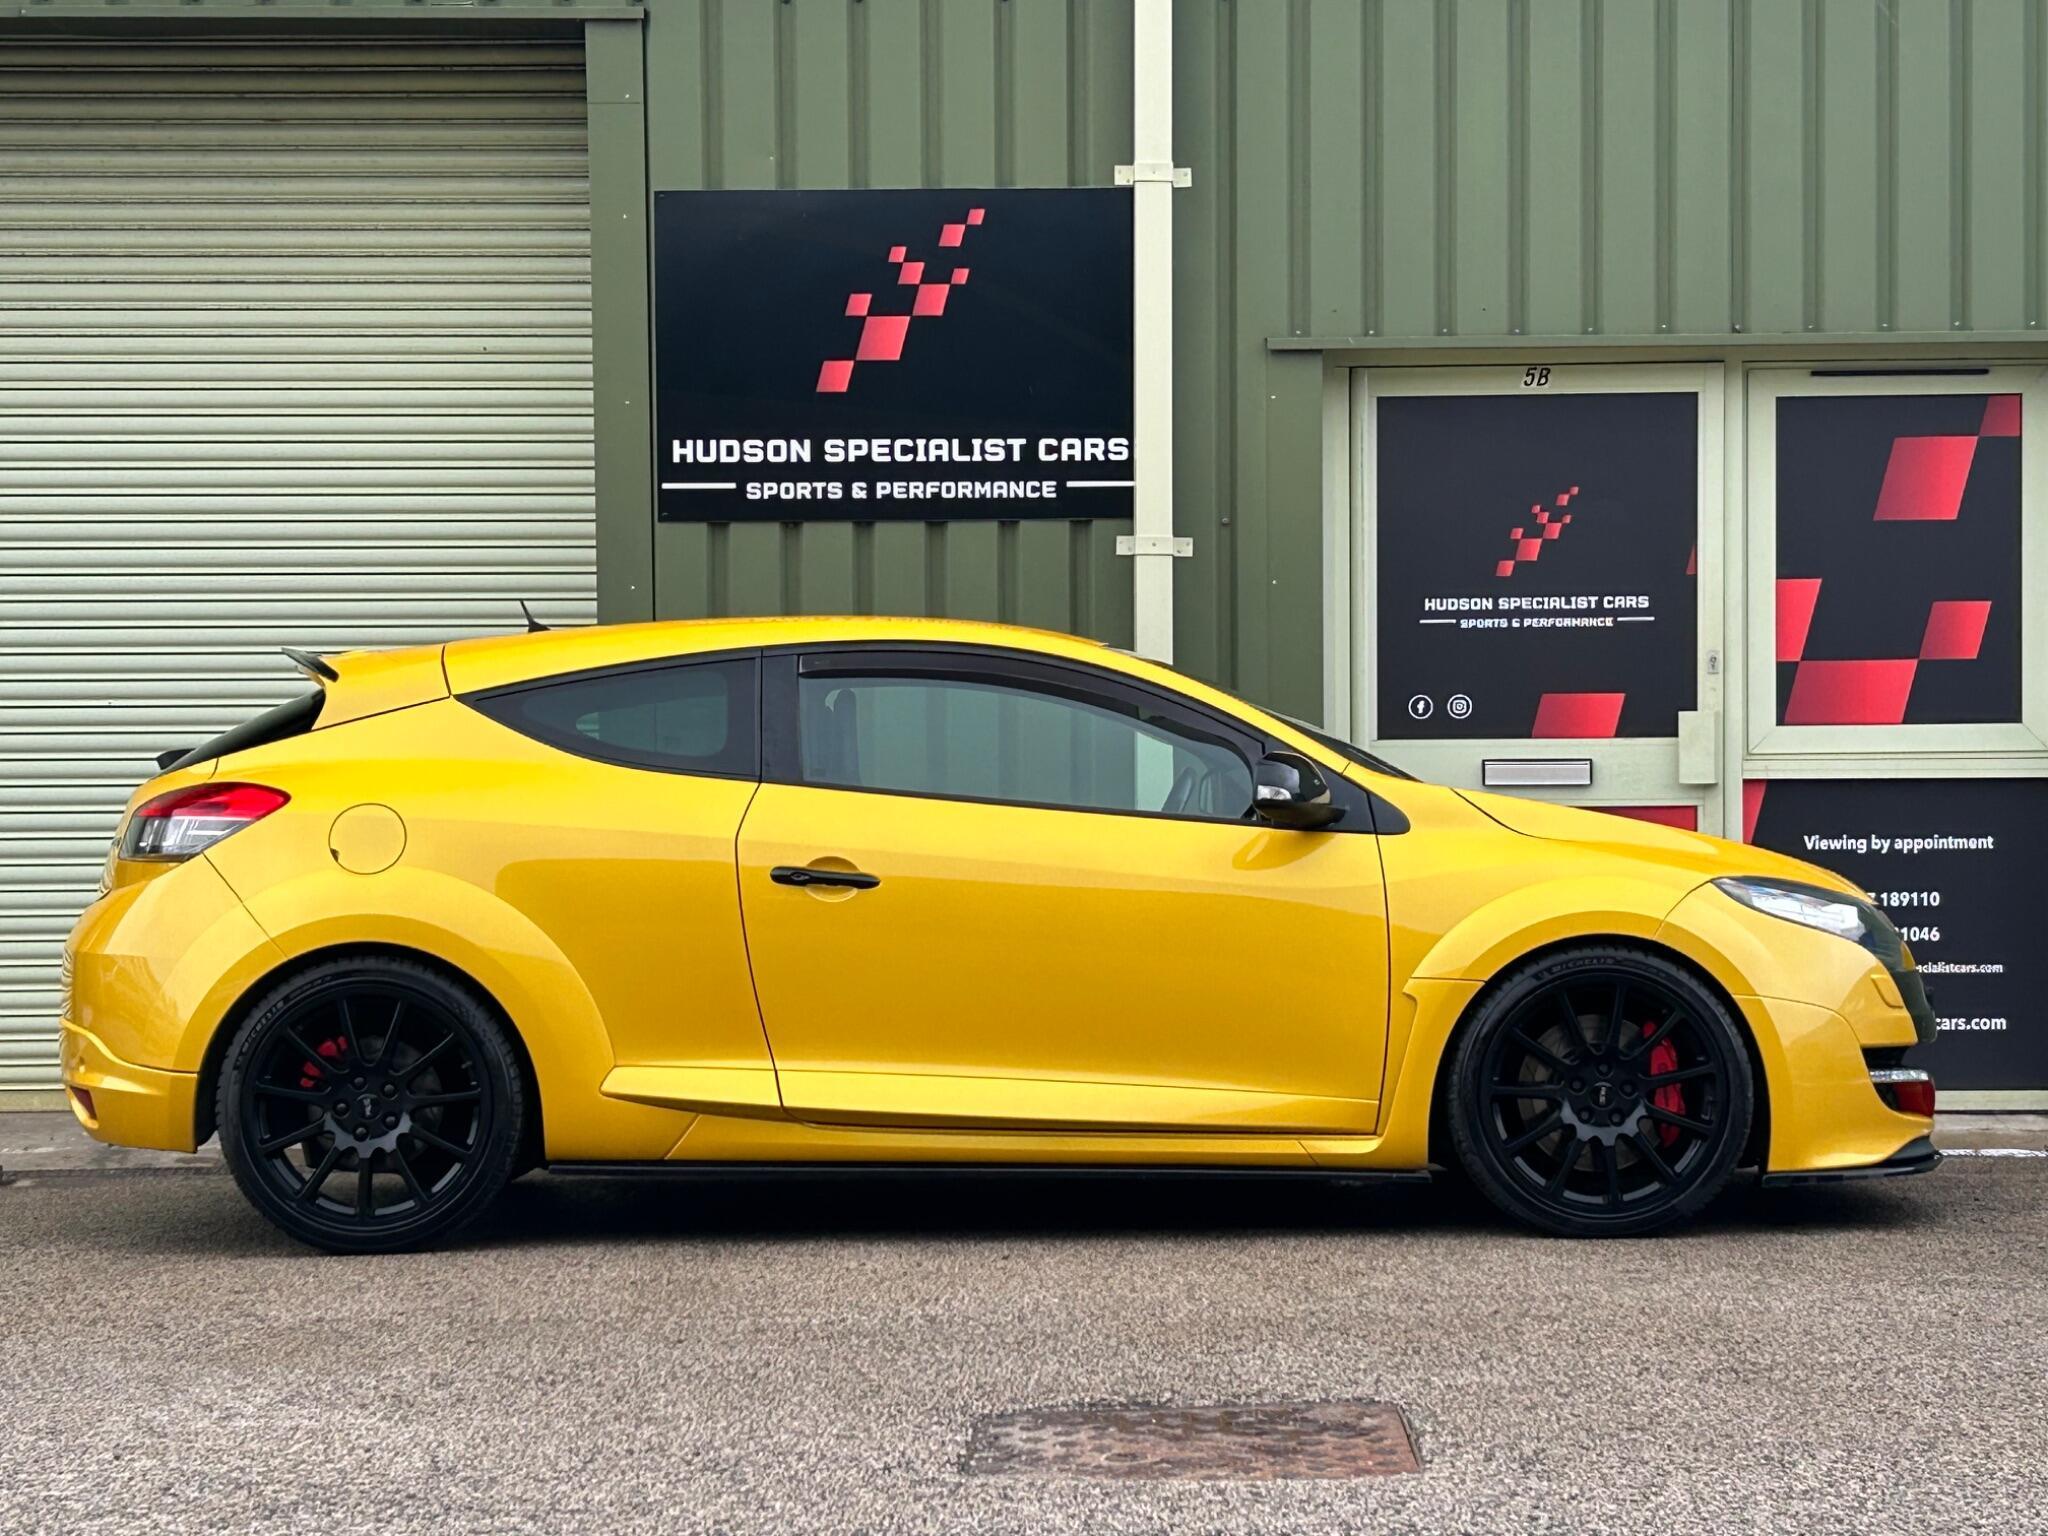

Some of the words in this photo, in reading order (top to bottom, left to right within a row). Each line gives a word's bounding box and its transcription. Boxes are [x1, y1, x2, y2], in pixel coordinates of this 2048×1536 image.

[1523, 366, 1551, 386] 5B
[672, 438, 811, 463] HUDSON
[824, 438, 1027, 463] SPECIALIST
[1038, 437, 1129, 462] CARS
[746, 481, 843, 500] SPORTS
[851, 481, 867, 499] &
[876, 480, 1057, 499] PERFORMANCE
[1424, 597, 1493, 611] HUDSON
[1498, 595, 1599, 610] SPECIALIST
[1602, 595, 1650, 609] CARS
[1459, 617, 1509, 629] SPORTS
[1511, 617, 1521, 628] &
[1523, 616, 1614, 628] PERFORMANCE
[1803, 834, 1867, 854] Viewing
[1871, 834, 1891, 854] by
[1893, 834, 1994, 854] appointment
[1880, 891, 1941, 907] 189110
[1894, 926, 1941, 942] 1046
